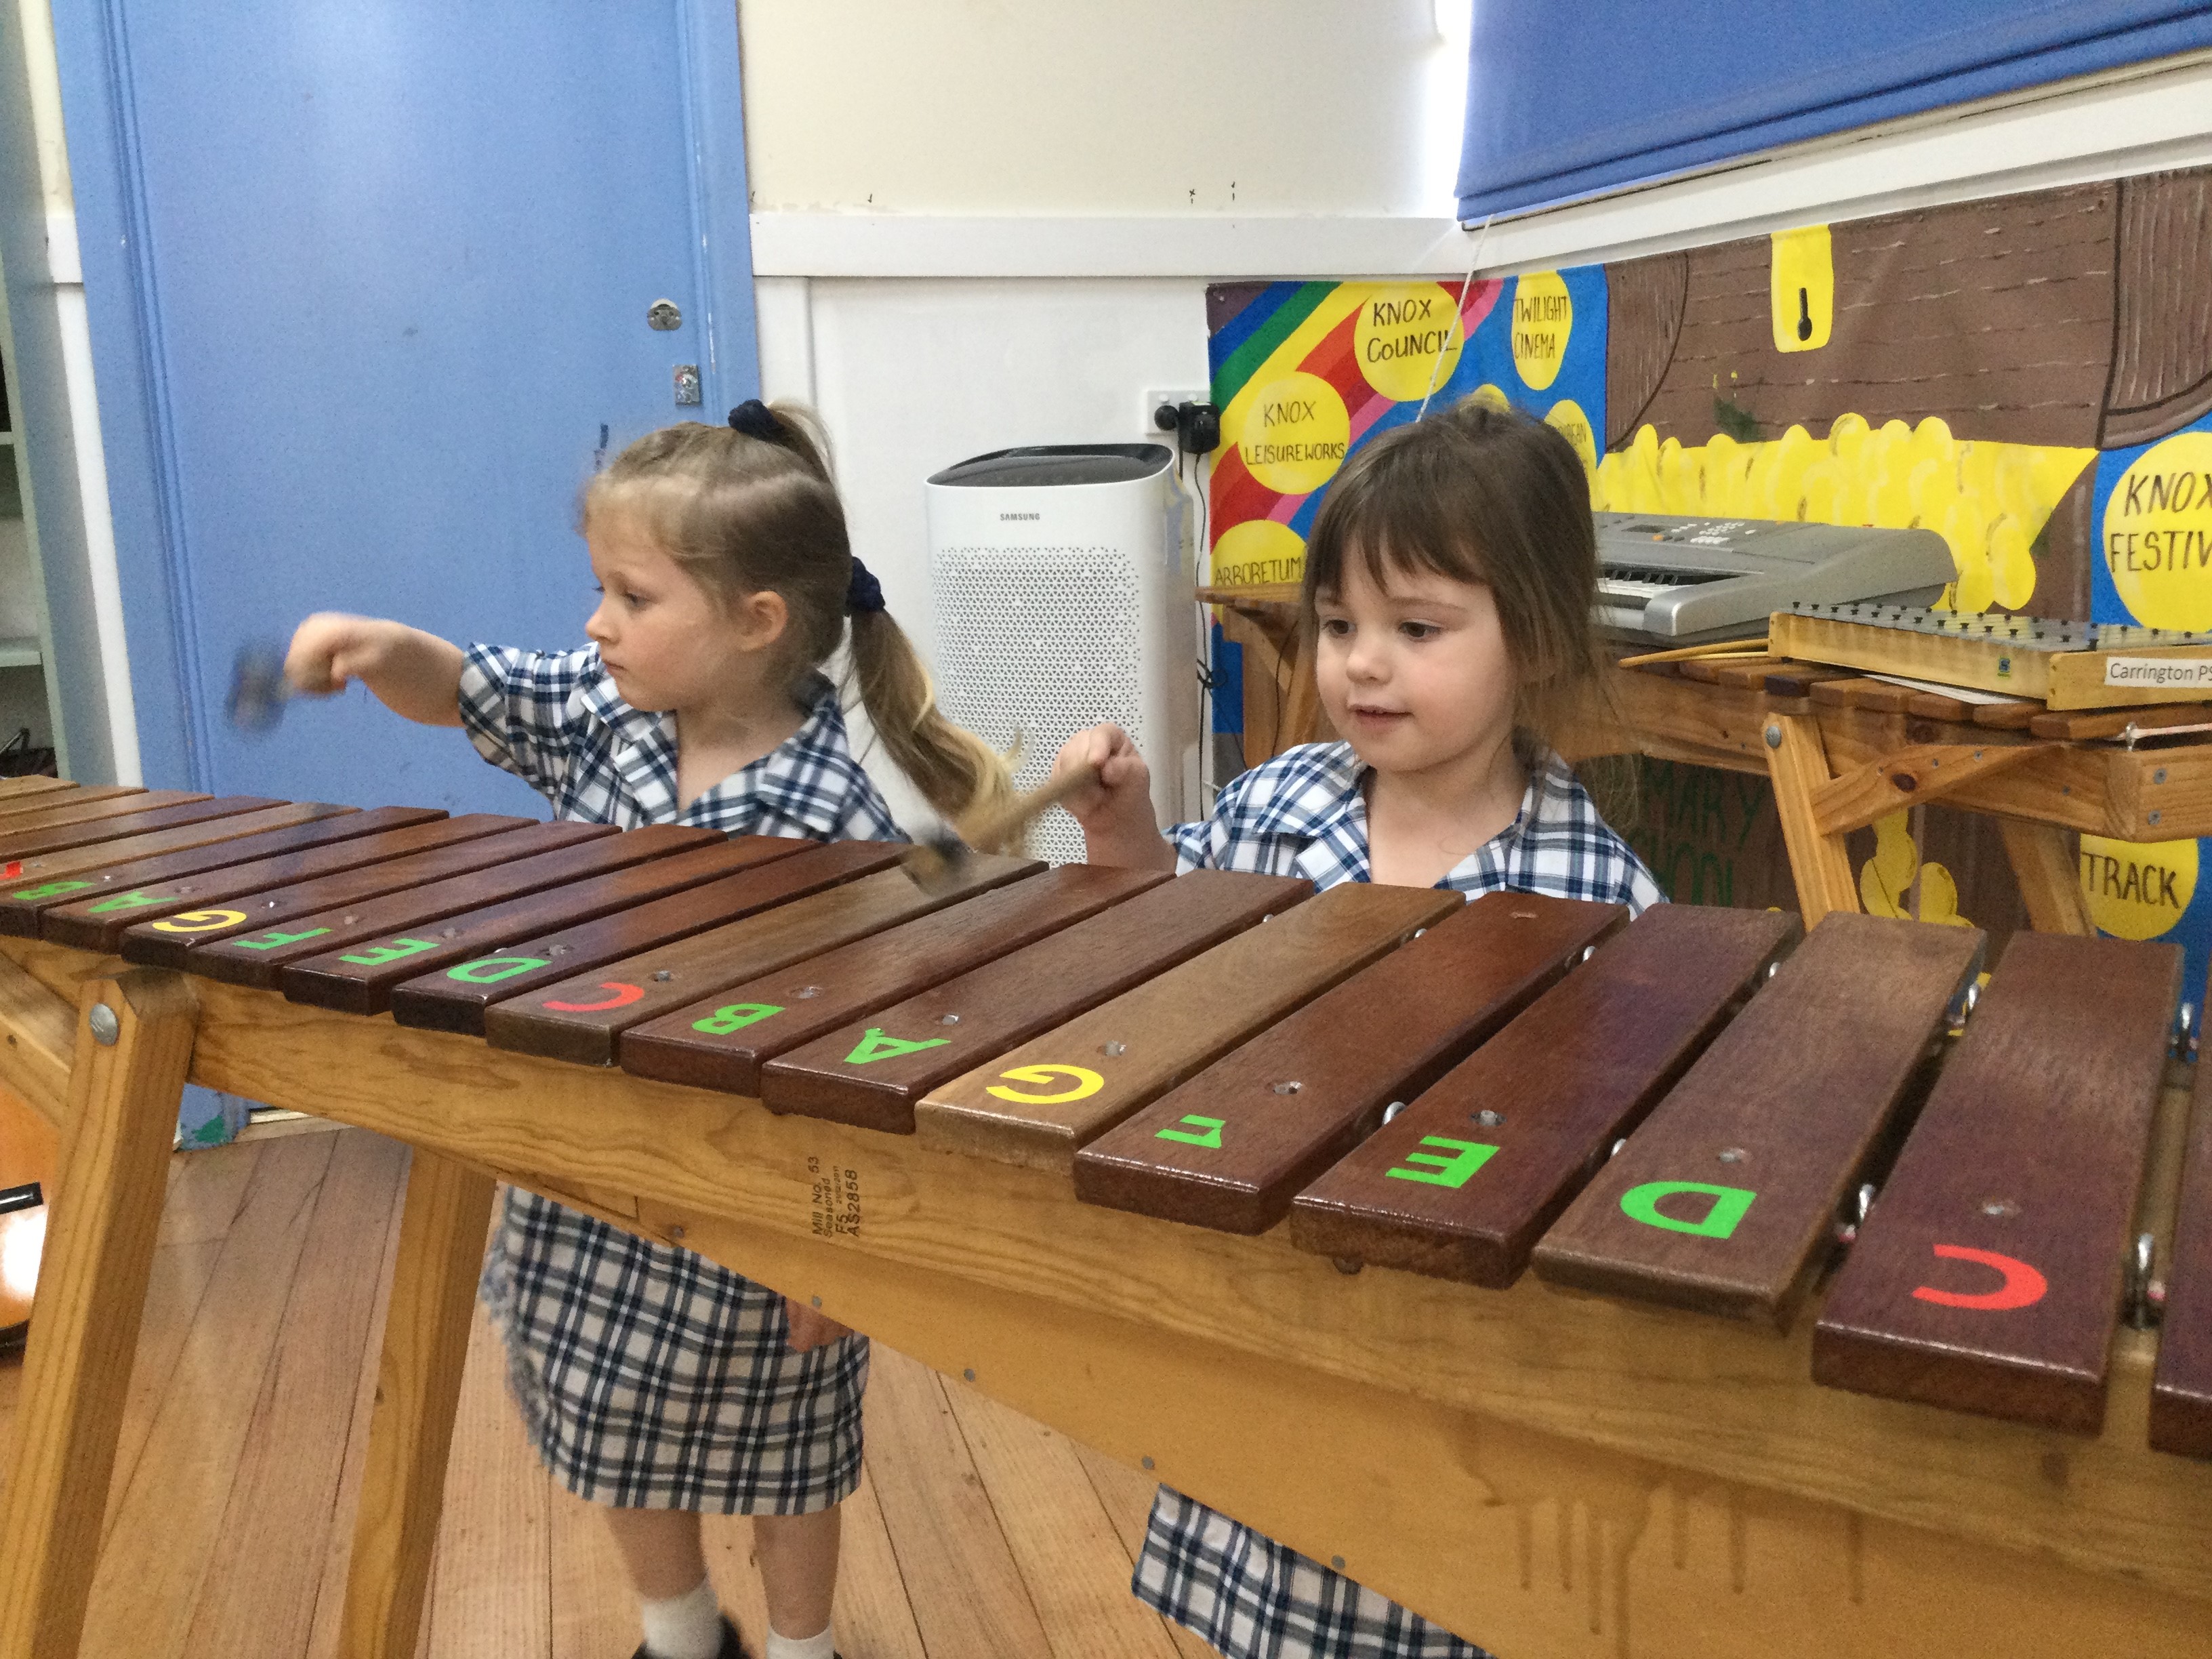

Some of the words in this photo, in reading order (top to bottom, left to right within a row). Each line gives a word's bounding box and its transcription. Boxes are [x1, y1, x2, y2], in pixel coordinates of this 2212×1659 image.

[1373, 299, 1431, 327] KNOX
[1514, 295, 1568, 323] TWILIGHT
[1514, 331, 1555, 359] CINEMA
[1263, 401, 1316, 428] KNOX
[1245, 442, 1345, 466] LEISUREWORKS
[2124, 472, 2212, 517] KNOX
[1000, 512, 1040, 521] SAMSUNG
[1214, 556, 1303, 586] ARBORETUM
[2110, 662, 2193, 684] Carrington
[2081, 852, 2179, 909] TRACK
[152, 909, 247, 932] G
[339, 939, 441, 966] E
[446, 958, 552, 983] D
[543, 982, 644, 1012] C
[691, 1003, 786, 1036] B
[843, 1027, 951, 1065] A
[986, 1063, 1105, 1105] G
[1385, 1135, 1500, 1189] E
[844, 1169, 861, 1237] AS2858
[1620, 1181, 1757, 1240] D
[811, 1212, 823, 1235] Mill
[1911, 1244, 2049, 1311] C
